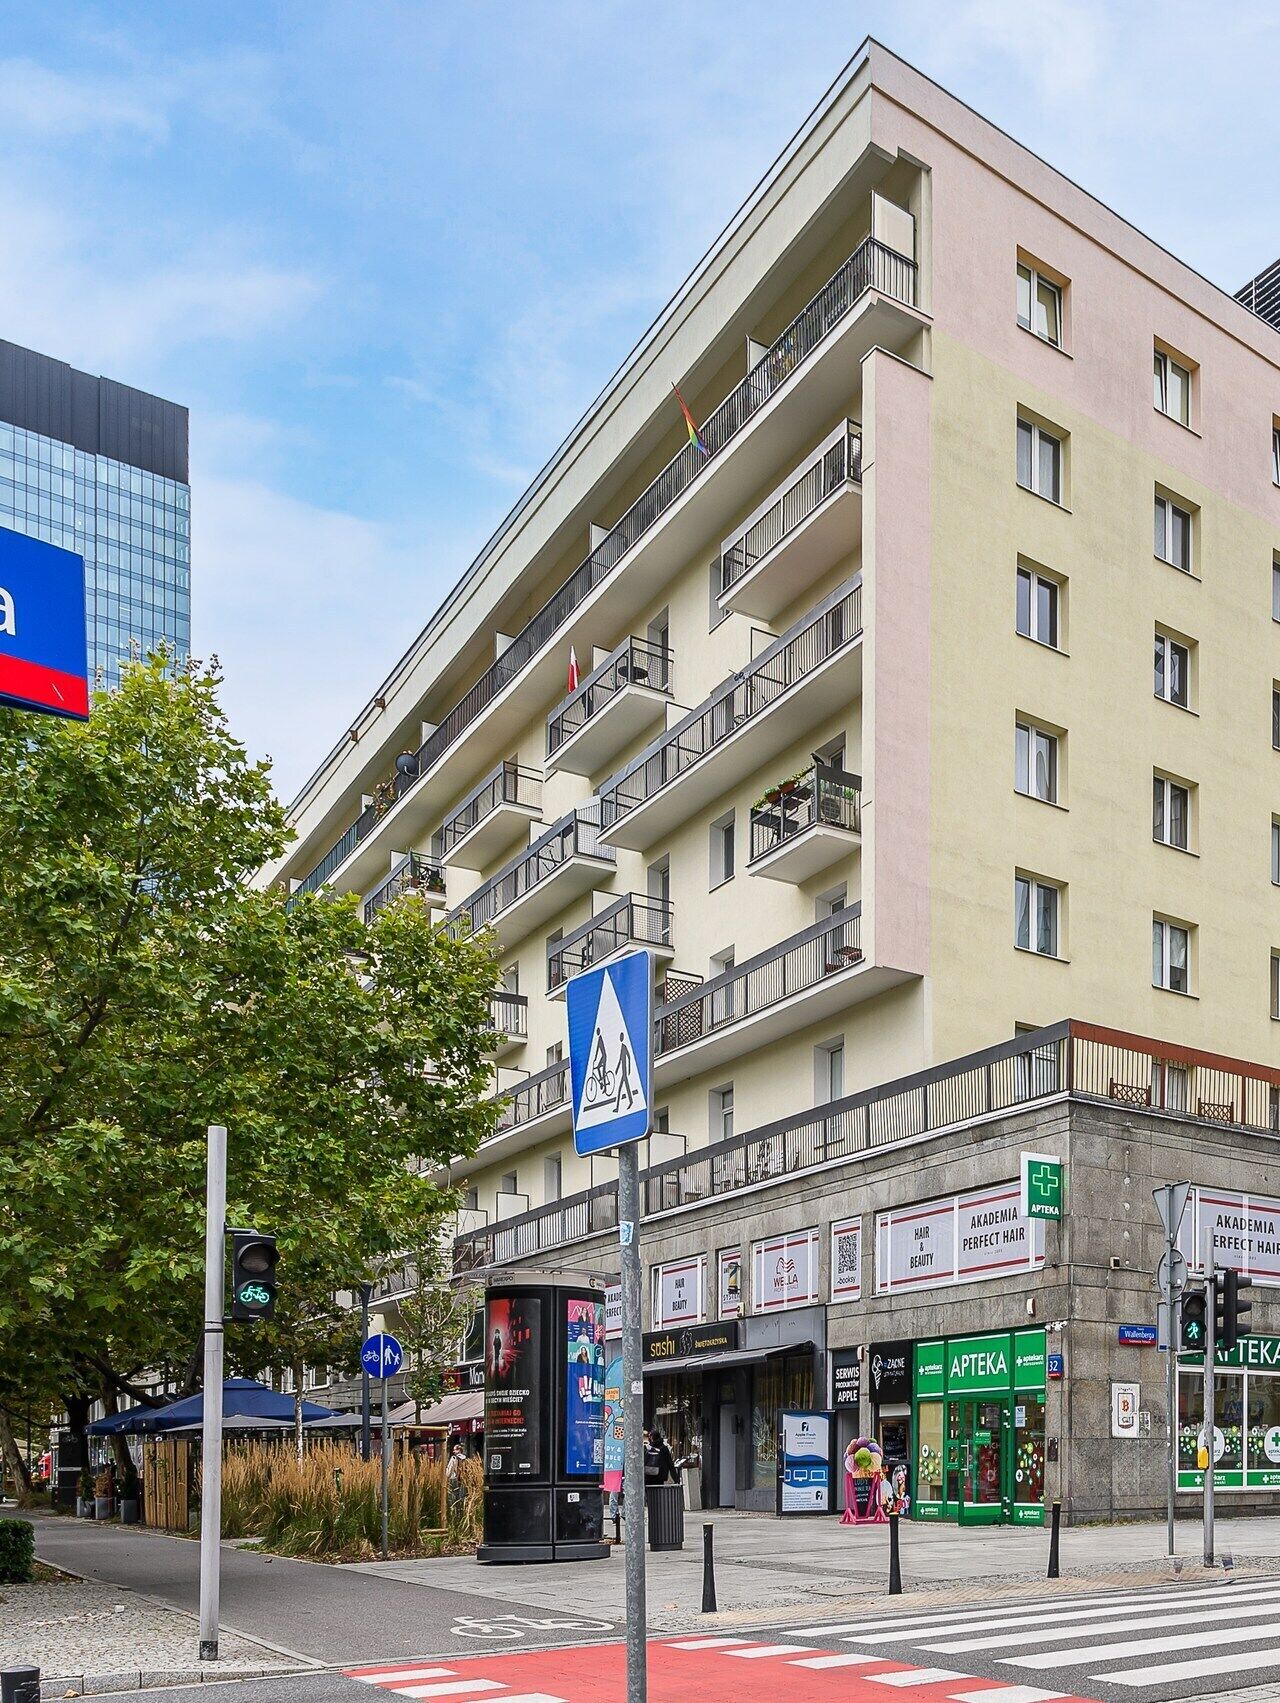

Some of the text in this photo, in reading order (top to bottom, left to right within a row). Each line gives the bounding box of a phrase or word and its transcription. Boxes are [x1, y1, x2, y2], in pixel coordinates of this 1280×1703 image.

[1031, 1203, 1060, 1216] APTEKA
[970, 1207, 1018, 1230] AKADEMIA
[1216, 1214, 1275, 1235] AKADEMIA
[914, 1226, 930, 1241] HAIR
[963, 1231, 1000, 1252] PERFECT
[1002, 1227, 1025, 1243] HAIR
[919, 1242, 924, 1252] &
[1213, 1235, 1253, 1252] ERFECT
[910, 1252, 934, 1269] BEAUTY
[674, 1277, 685, 1289] HAIR
[672, 1300, 687, 1312] BEAUTY
[1124, 1330, 1155, 1341] Wallenberga
[950, 1350, 1008, 1378] APTEKA
[1023, 1354, 1044, 1363] aptekarz
[1049, 1360, 1058, 1371] 32
[835, 1366, 860, 1380] SERWIS
[837, 1390, 858, 1403] APPLE
